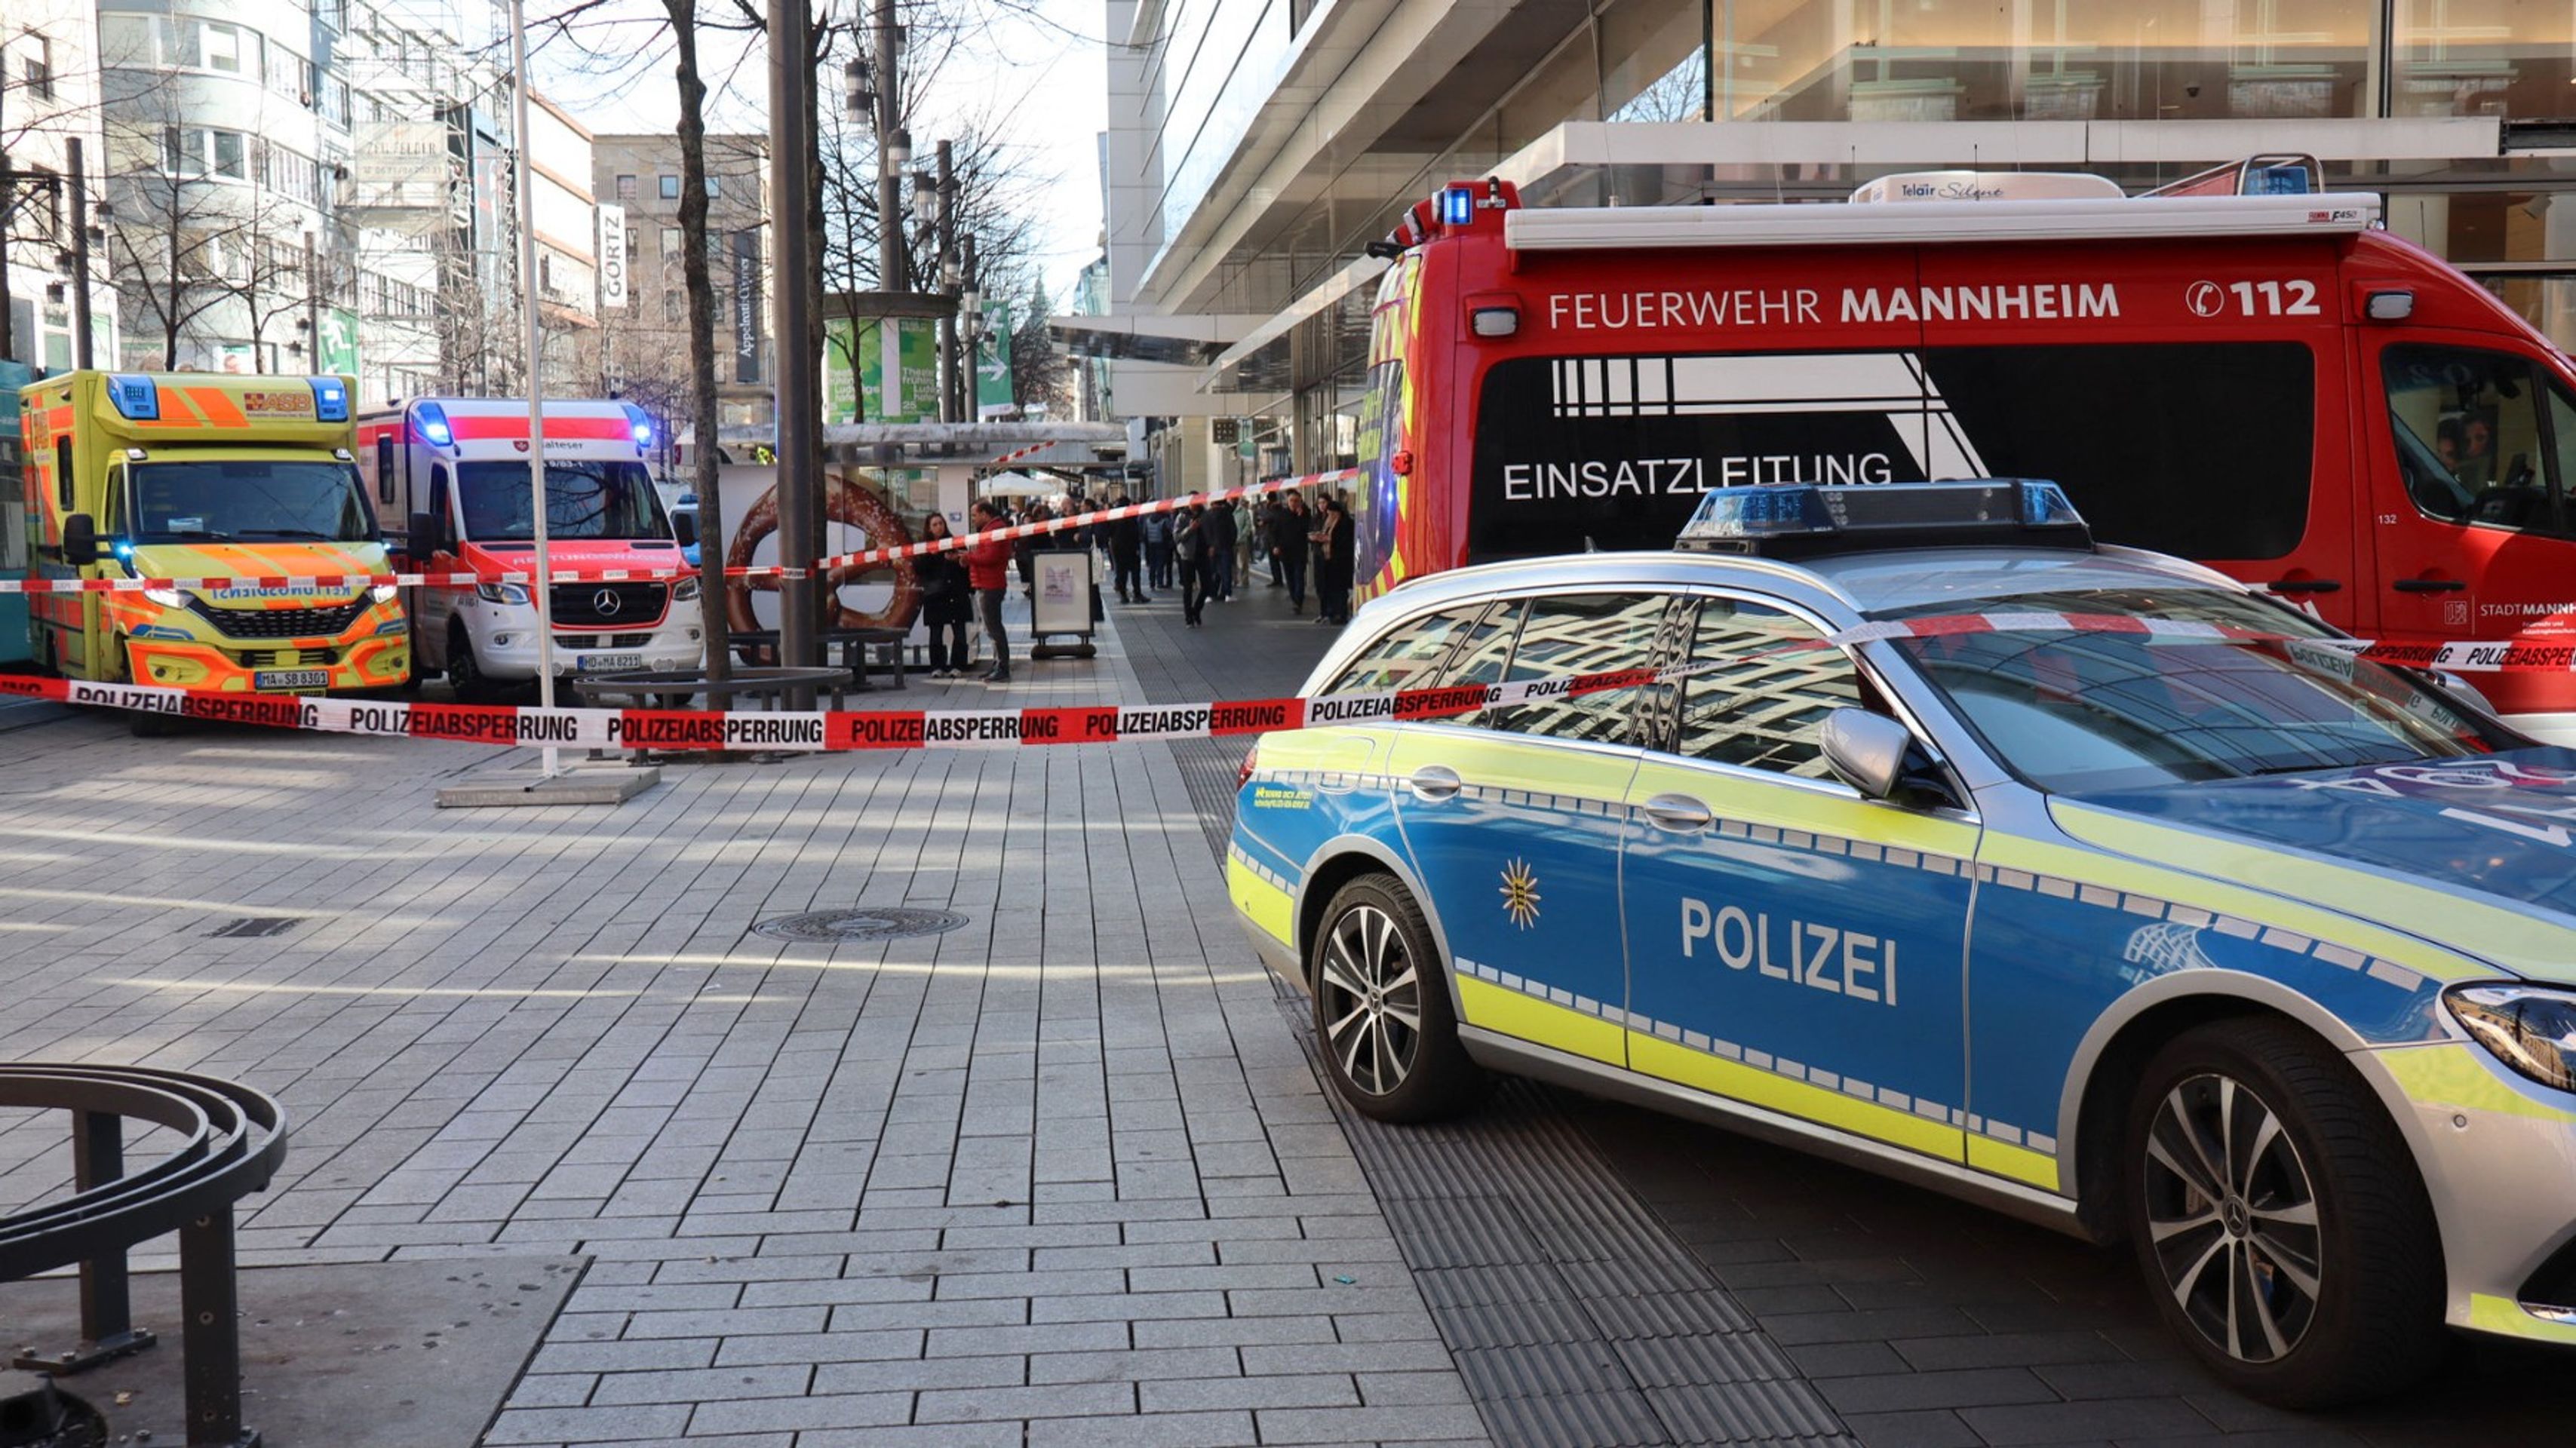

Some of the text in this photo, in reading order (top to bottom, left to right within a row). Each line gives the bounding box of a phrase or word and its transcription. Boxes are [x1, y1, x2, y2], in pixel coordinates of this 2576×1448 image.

[1902, 185, 1935, 196] Telair
[1549, 284, 2120, 329] FEUERWEHR MANNHEIM
[2230, 280, 2320, 316] 112
[266, 393, 312, 411] ASB
[1504, 453, 1892, 500] EINSATZLEITUNG
[2378, 514, 2396, 525] 132
[263, 670, 326, 684] MA SB 8301
[350, 707, 578, 741] POLIZEIABSPERRUNG
[607, 717, 824, 744] POLIZEIABSPERRUNG
[852, 715, 1058, 743] POLIZEIABSPERRUNG
[1085, 708, 1285, 736] POLIZEIABSPERRUNG
[1311, 686, 1503, 722] POLIZEIABSPERRUNG
[1681, 897, 1896, 1006] POLIZEI
